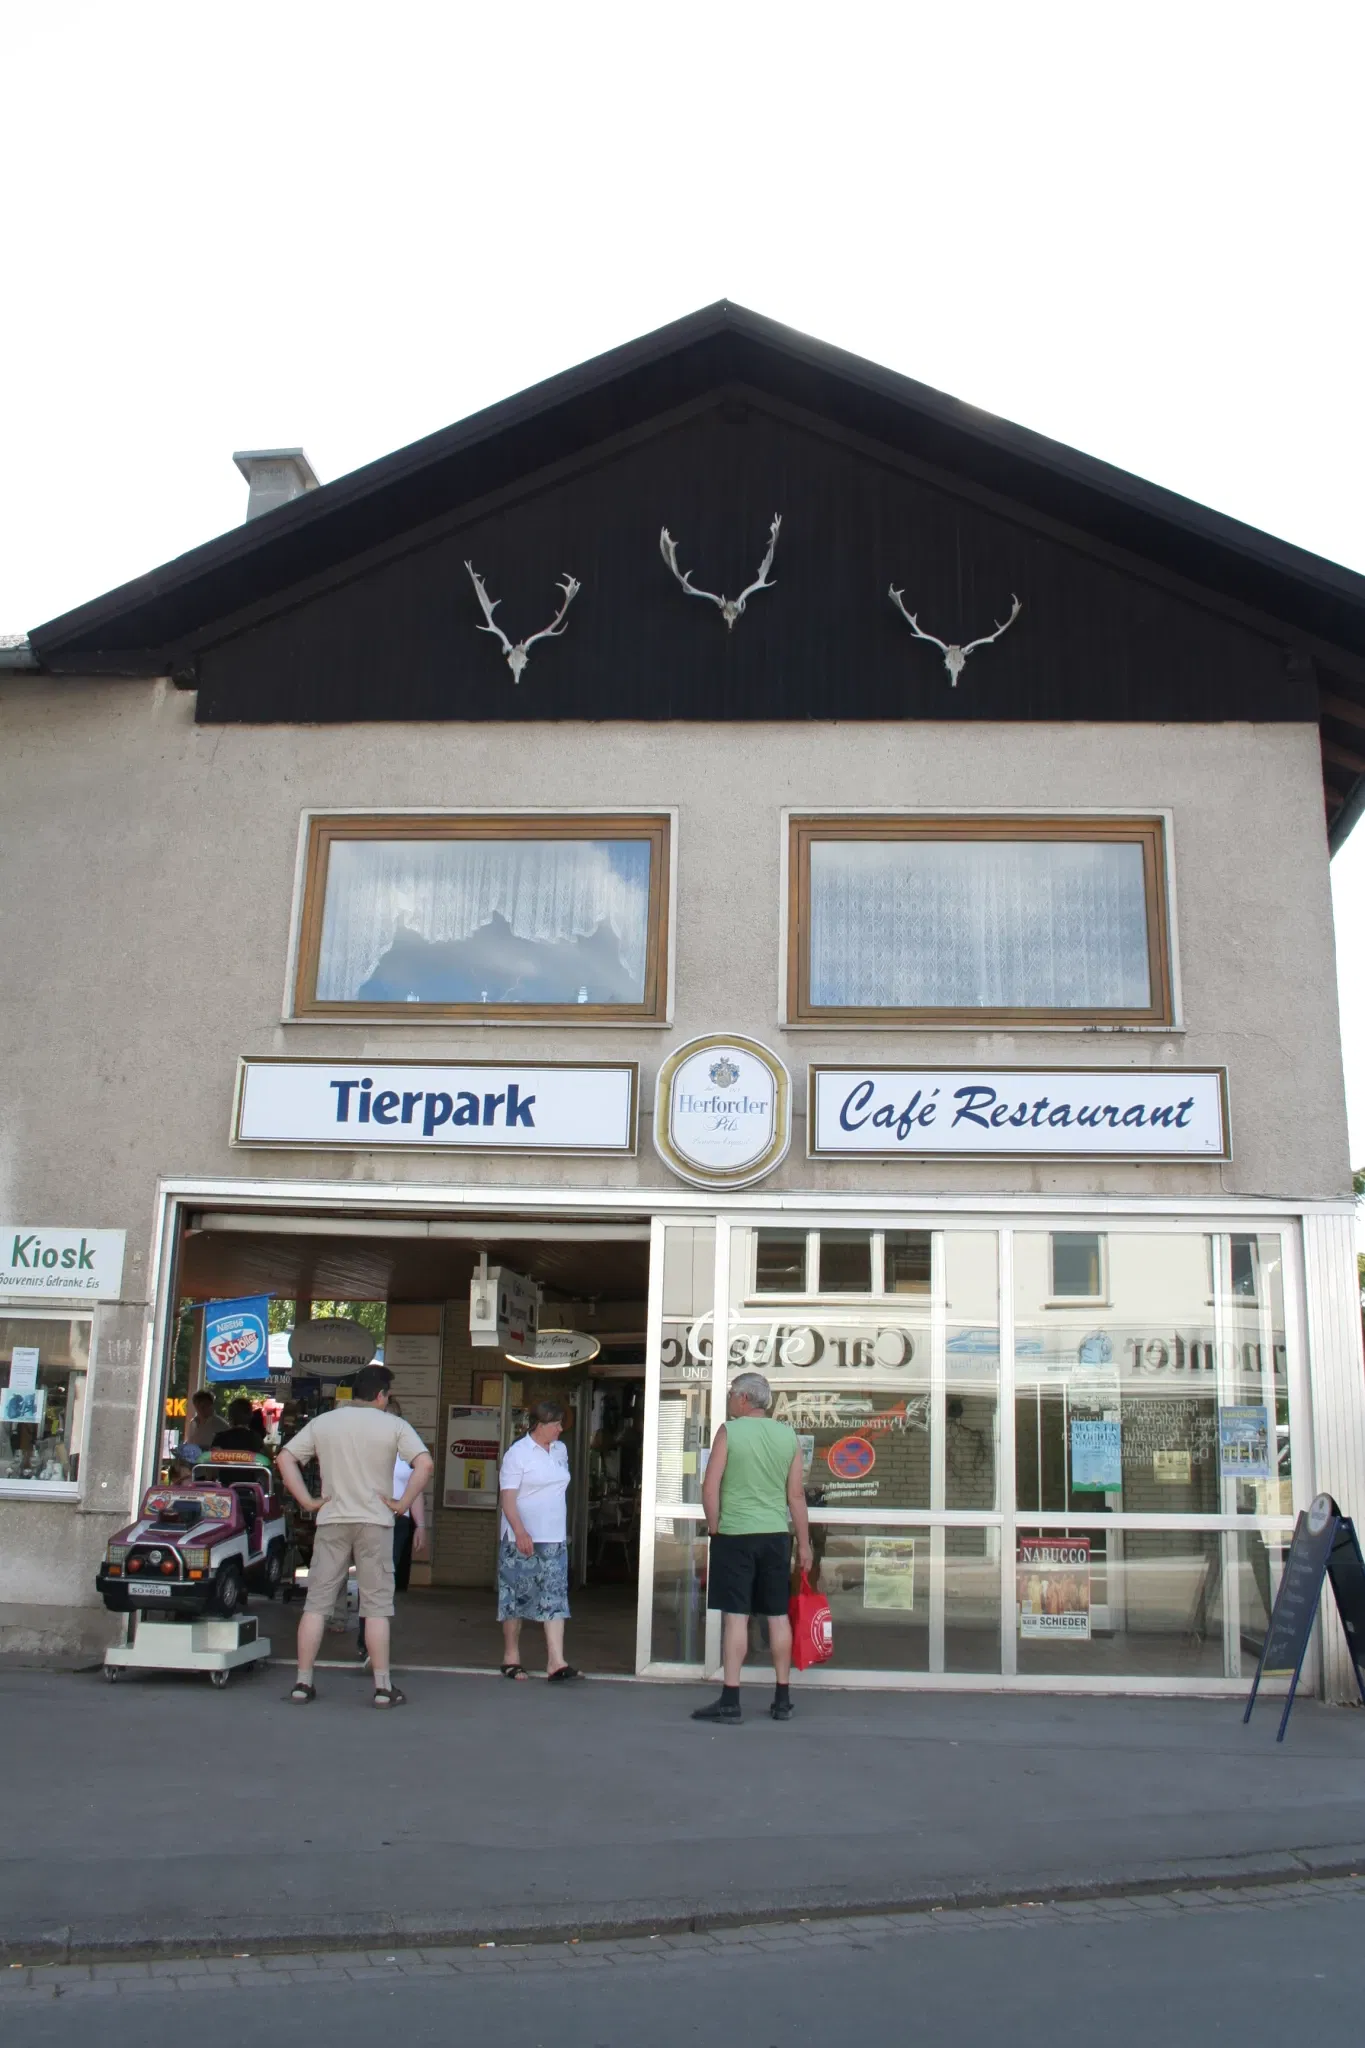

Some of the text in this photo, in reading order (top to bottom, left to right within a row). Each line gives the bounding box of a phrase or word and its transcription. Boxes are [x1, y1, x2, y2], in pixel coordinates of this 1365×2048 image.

[330, 1077, 536, 1136] Tierpark
[679, 1094, 769, 1115] Herforder
[839, 1080, 1196, 1141] Café Restaurant
[703, 1115, 741, 1131] Pils
[11, 1235, 97, 1270] Kiosk
[86, 1277, 100, 1289] Eis
[215, 1332, 258, 1363] Schöller
[682, 1368, 710, 1379] UND
[212, 1452, 253, 1462] CONTROL
[1023, 1547, 1087, 1564] NABUCCO
[1039, 1616, 1087, 1627] SCHIEDER
